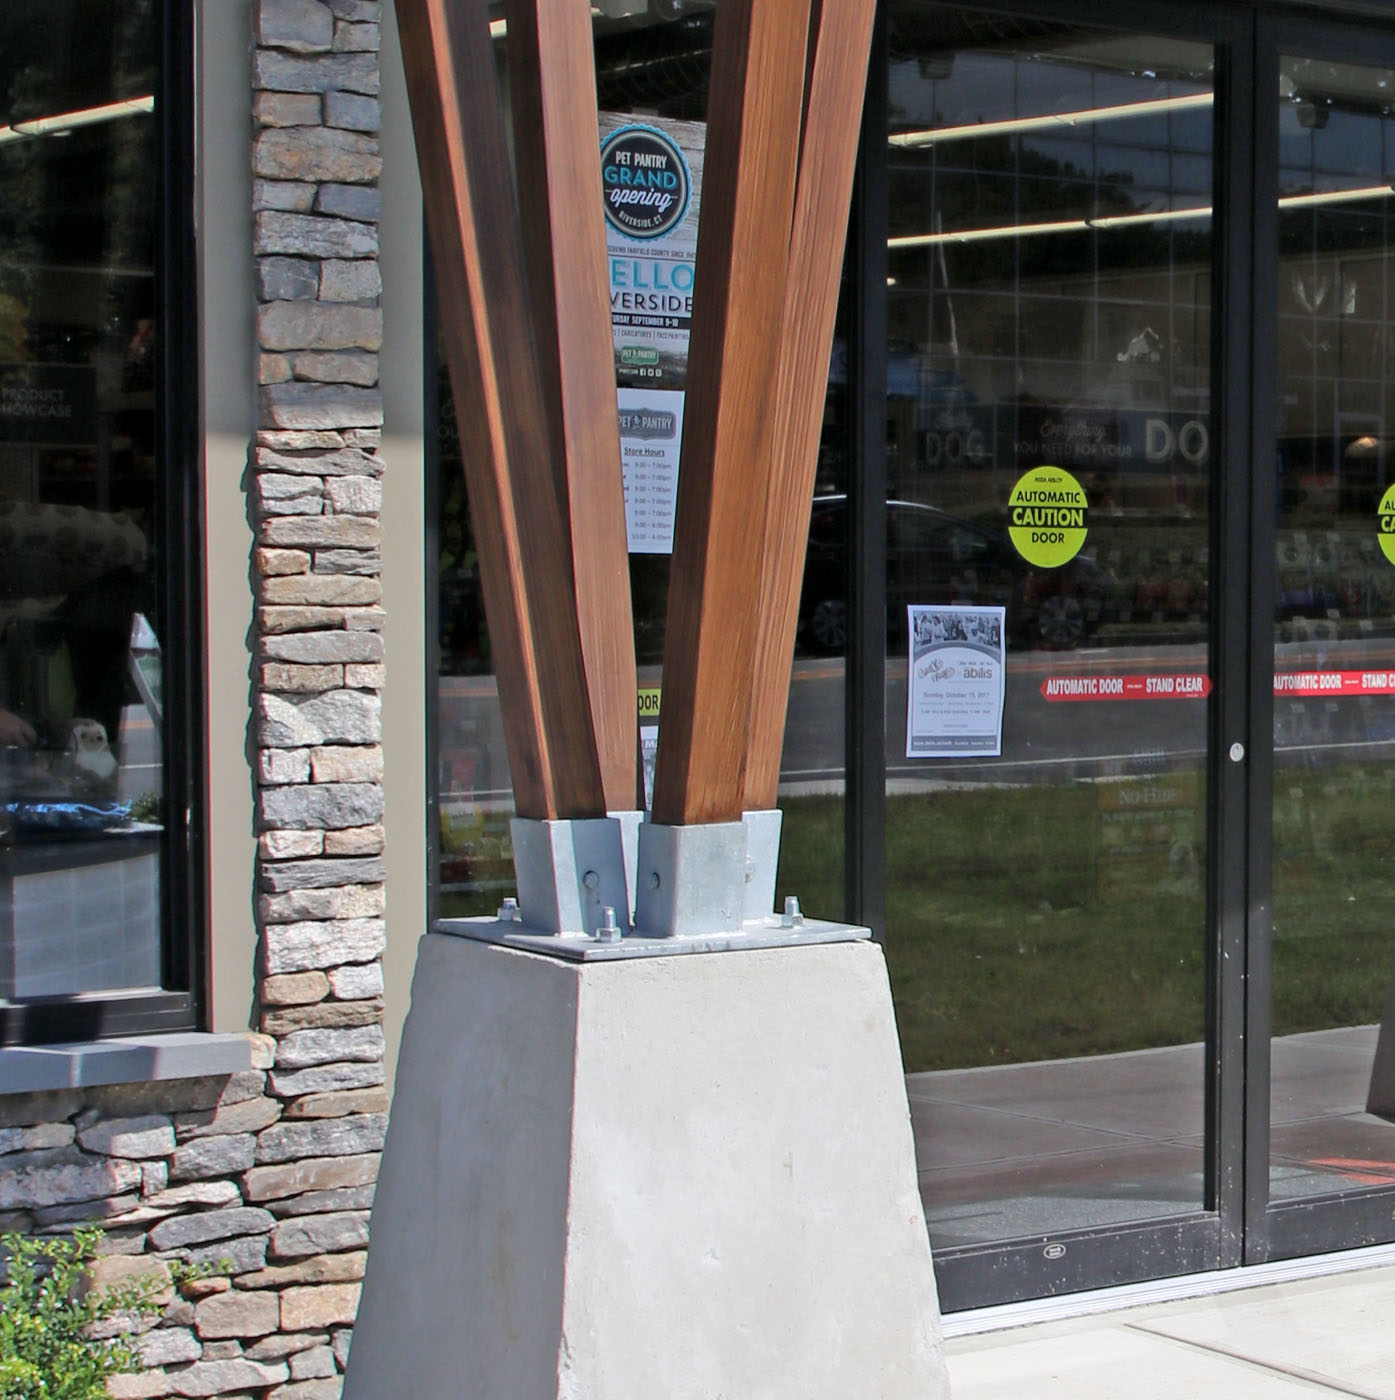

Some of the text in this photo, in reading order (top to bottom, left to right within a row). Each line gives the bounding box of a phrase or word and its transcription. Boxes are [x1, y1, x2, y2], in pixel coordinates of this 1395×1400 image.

[615, 151, 667, 169] PET PANTRY
[604, 165, 678, 190] GRAND
[610, 188, 672, 213] opening
[611, 259, 694, 291] ELLO
[610, 291, 693, 312] VERSIDE
[632, 315, 664, 326] SEPTEMBER
[642, 416, 672, 430] PANTRY
[1145, 419, 1209, 463] DO
[1016, 490, 1081, 504] AUTOMATIC
[1012, 507, 1084, 527] CAUTION
[1031, 532, 1065, 544] DOOR
[963, 667, 993, 679] abilis
[1273, 675, 1318, 691] AUTOMATIC
[1319, 674, 1342, 689] DOOR
[1361, 673, 1387, 689] STAND
[1046, 676, 1203, 695] AUTOMATIC DOOR STAND CLEAR
